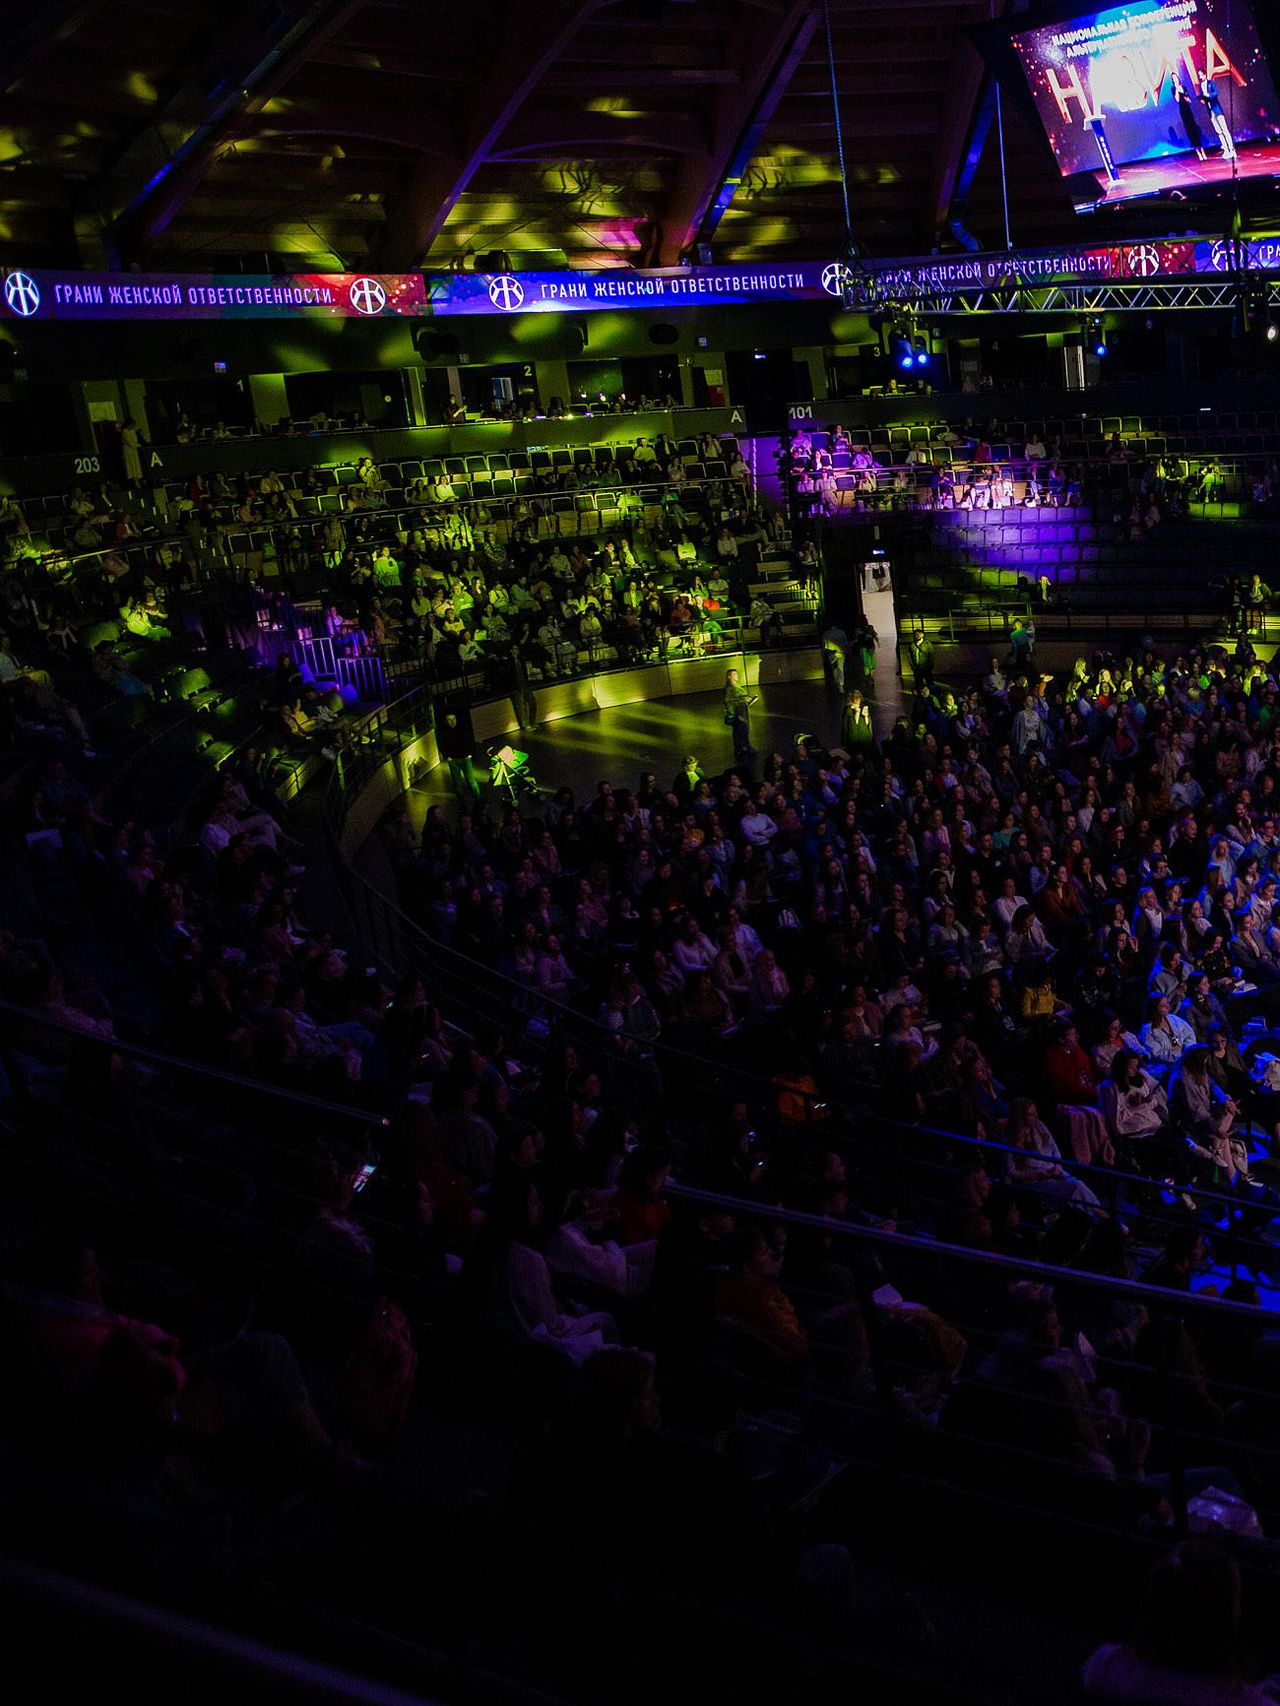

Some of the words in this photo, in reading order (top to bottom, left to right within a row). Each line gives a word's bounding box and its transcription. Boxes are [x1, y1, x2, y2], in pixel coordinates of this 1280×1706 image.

[55, 285, 103, 304] ГРАНИ
[109, 283, 182, 304] ЖЕНСКОЙ
[188, 286, 333, 305] ОТВЕТСТВЕННОСТИ
[541, 283, 588, 299] ГРАНИ
[594, 279, 664, 297] ЖЕНСКОЙ
[671, 273, 804, 294] ОТВЕТСТВЕННОСТИ
[873, 346, 881, 357] 3
[523, 365, 533, 377] 2
[236, 379, 244, 392] 1
[788, 405, 813, 421] 101
[74, 457, 100, 474] 203
